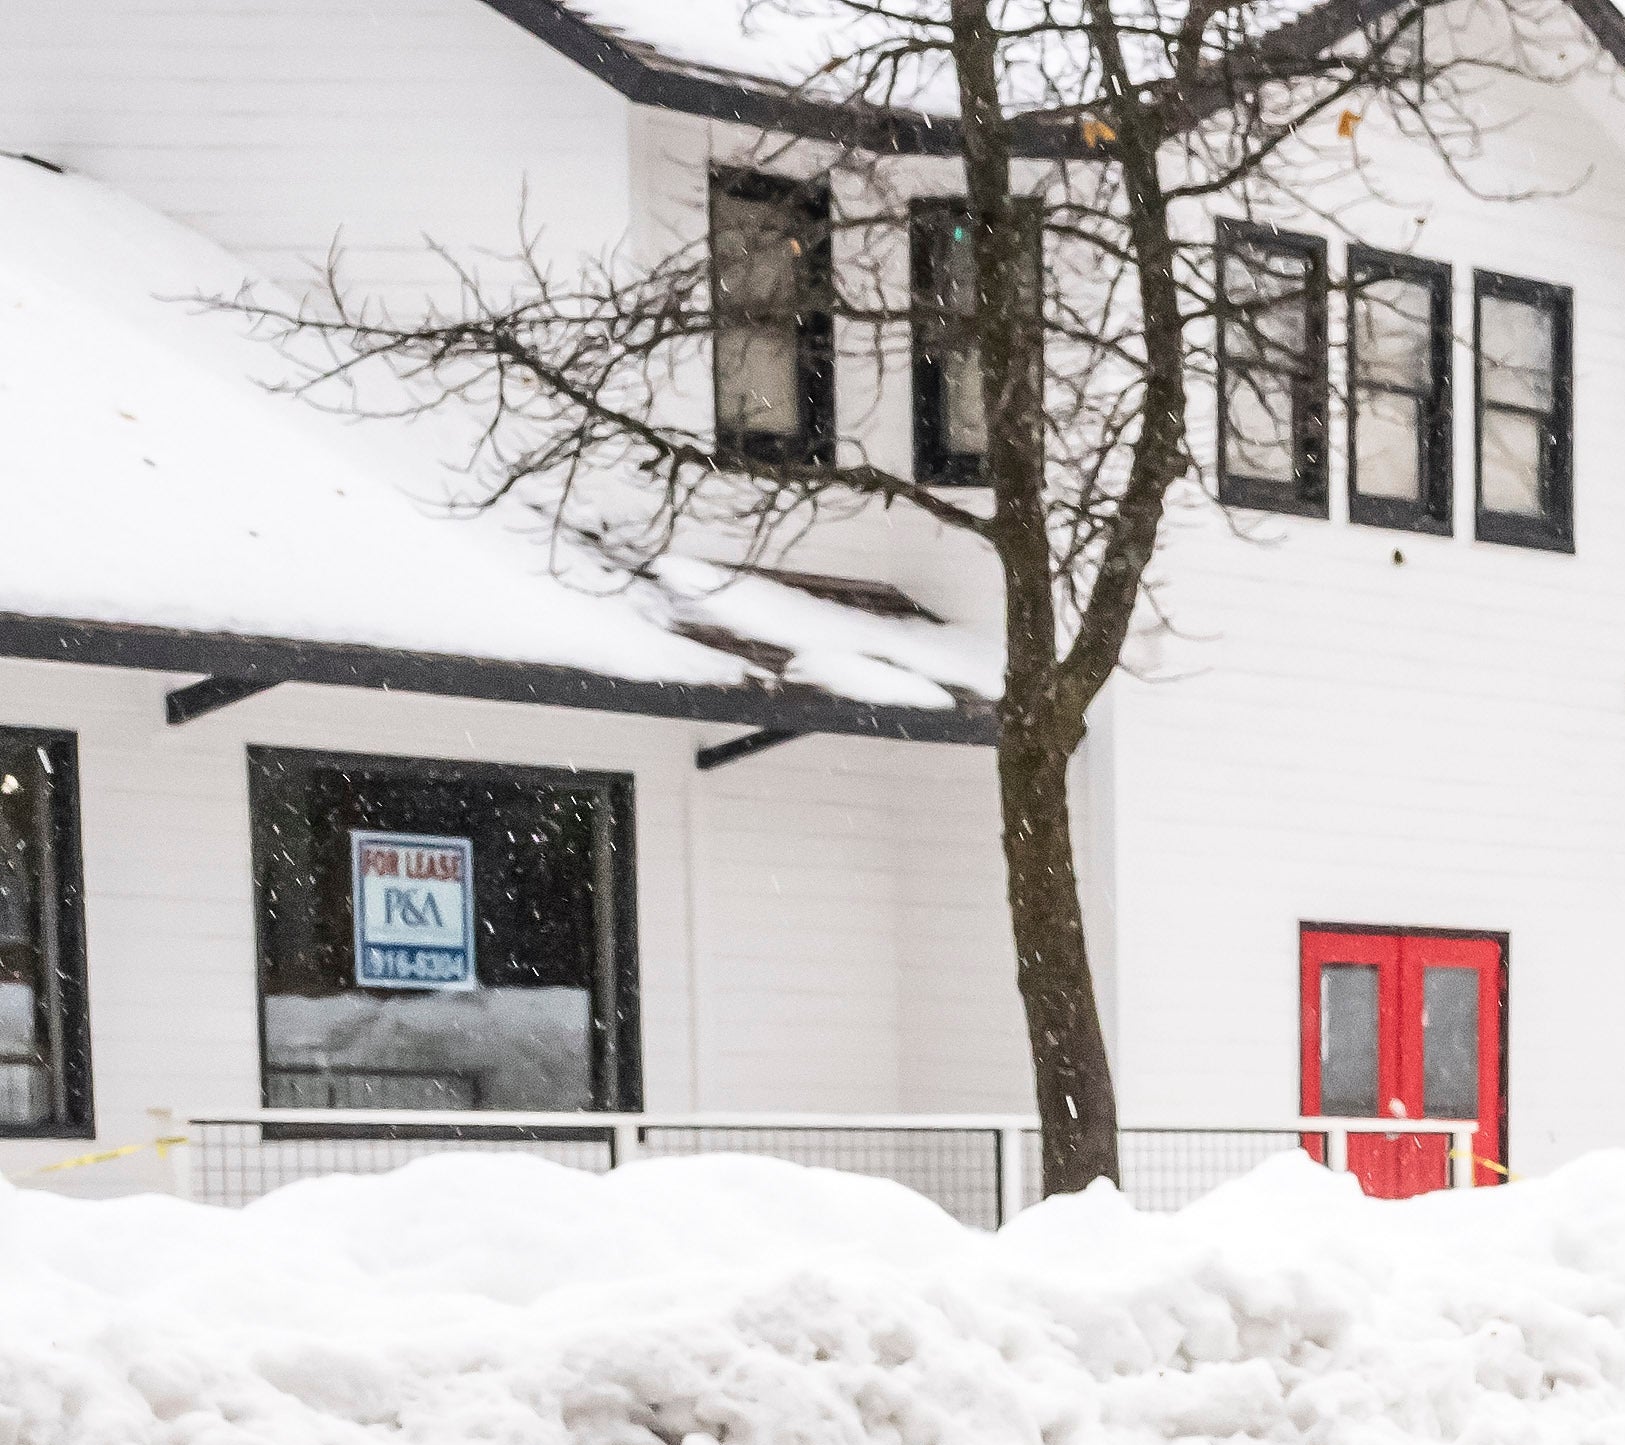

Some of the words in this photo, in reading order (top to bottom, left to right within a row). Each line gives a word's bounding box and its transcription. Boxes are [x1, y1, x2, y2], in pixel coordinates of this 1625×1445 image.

[363, 849, 399, 876] FOR
[405, 851, 463, 882] LEASE
[384, 887, 443, 928] P&A
